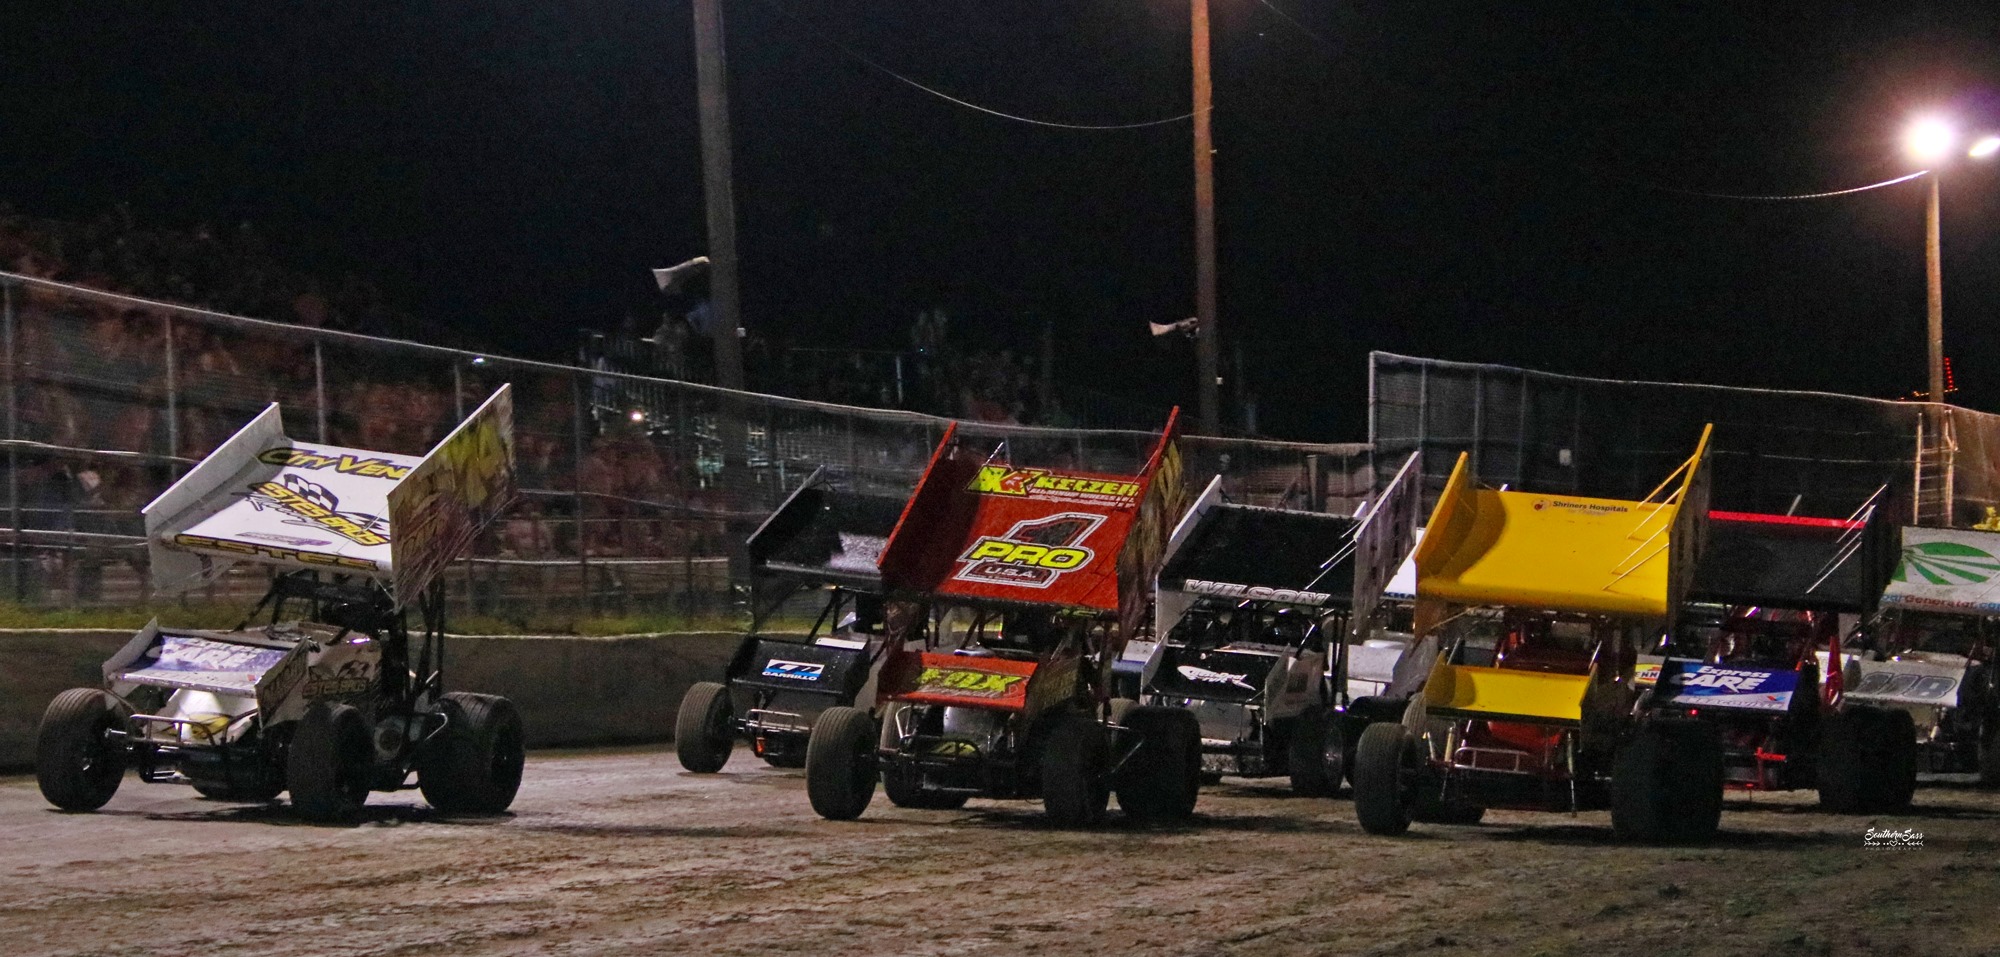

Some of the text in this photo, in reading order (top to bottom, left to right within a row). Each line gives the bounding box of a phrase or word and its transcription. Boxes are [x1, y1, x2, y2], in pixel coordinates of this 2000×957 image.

[1032, 475, 1140, 497] KEIZER
[1552, 500, 1588, 510] Shriners
[1589, 503, 1629, 513] Hospitals
[968, 540, 1087, 569] PRO
[984, 566, 1037, 579] U.S.A.
[1183, 578, 1332, 606] WILSON
[761, 670, 819, 682] CARRILLO
[1696, 664, 1772, 679] Express
[1668, 672, 1767, 694] CARE
